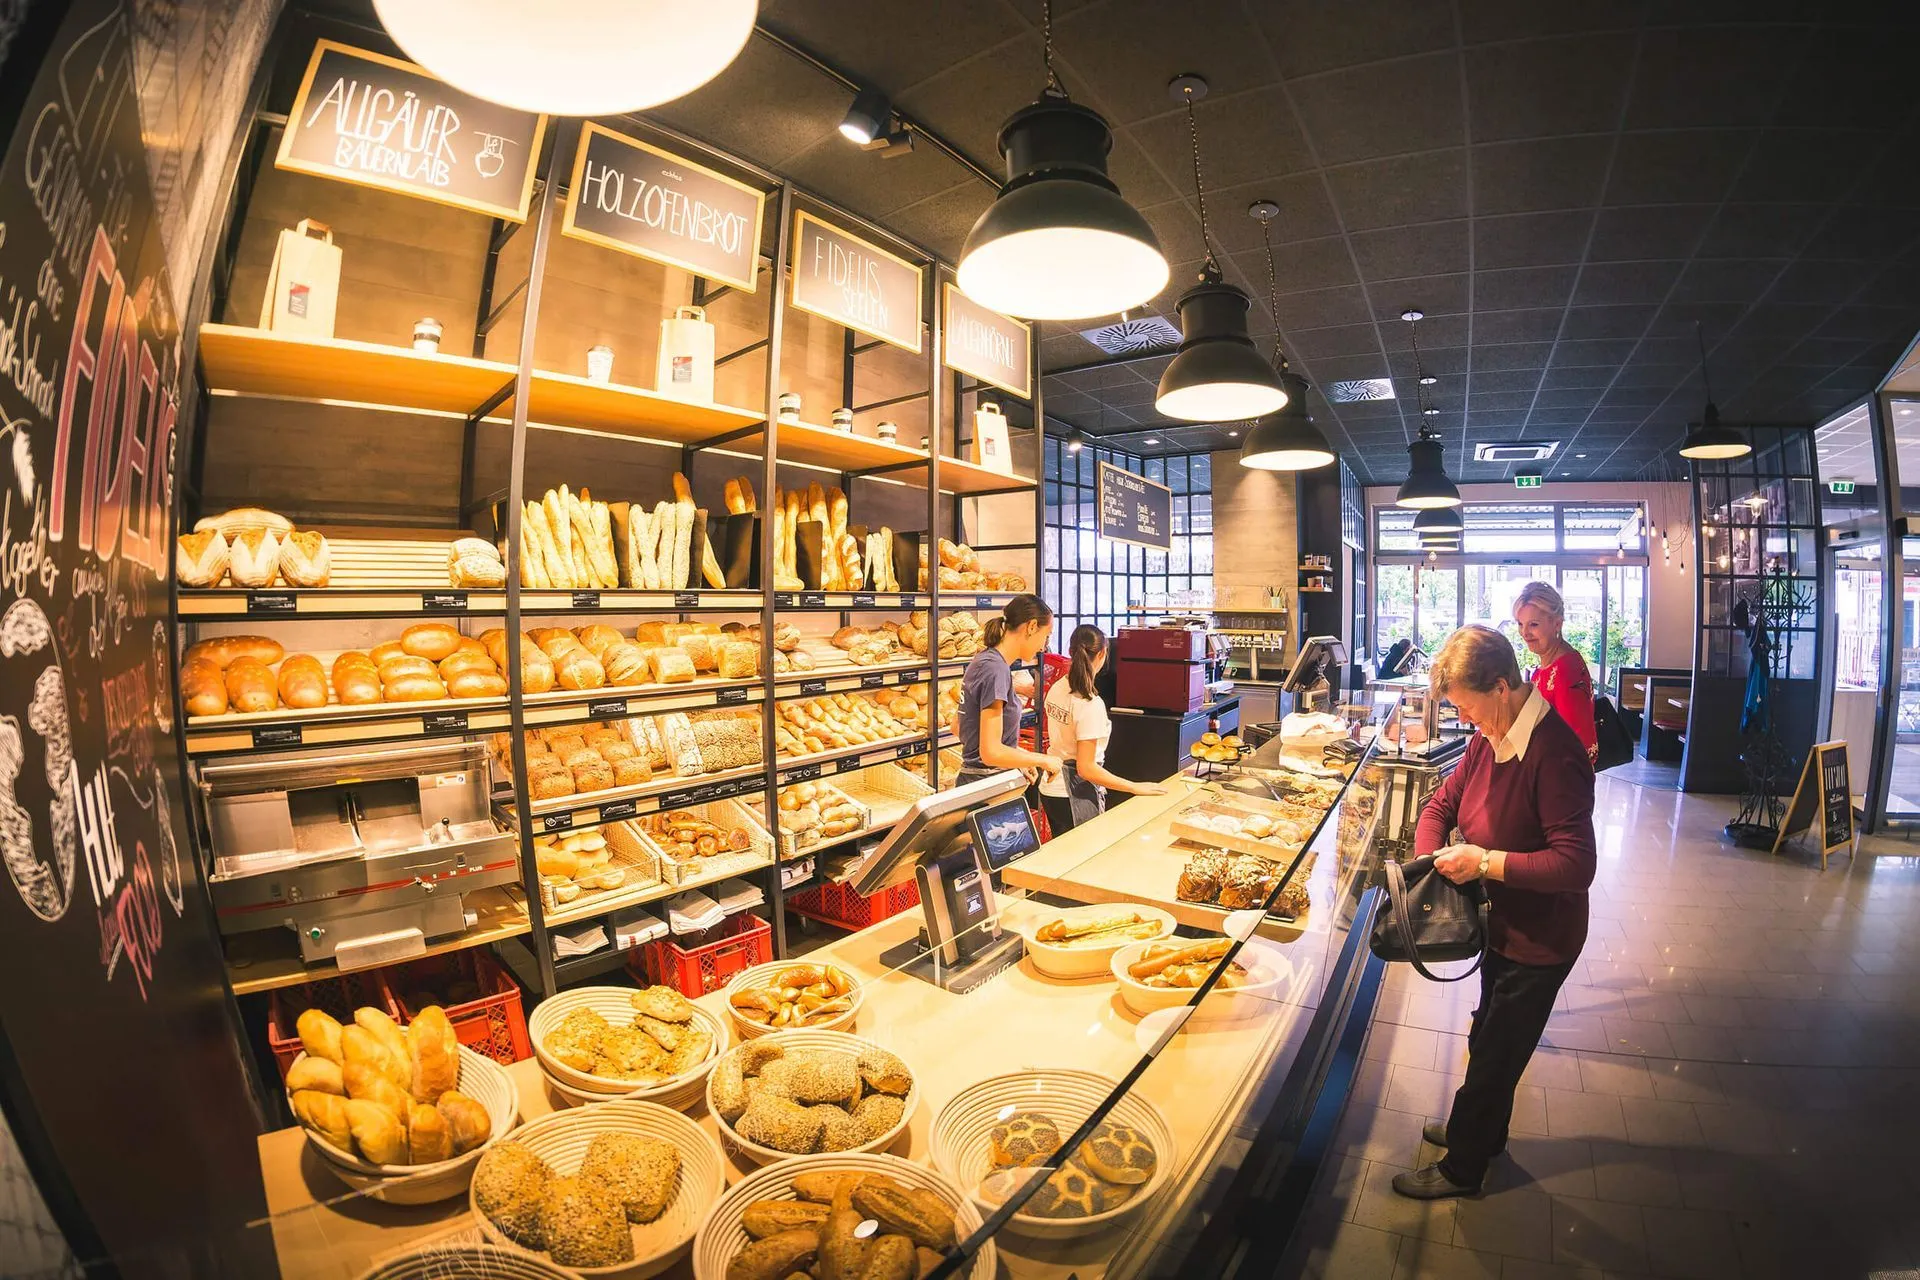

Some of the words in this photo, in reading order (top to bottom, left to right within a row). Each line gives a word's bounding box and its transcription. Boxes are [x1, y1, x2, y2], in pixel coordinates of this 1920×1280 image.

[306, 76, 460, 164] ALLGÄUER
[334, 134, 451, 187] BAUERNLAIB
[582, 159, 748, 257] HOLZOFENBROT
[814, 235, 882, 303] FIDELIS
[469, 865, 484, 873] PLUS
